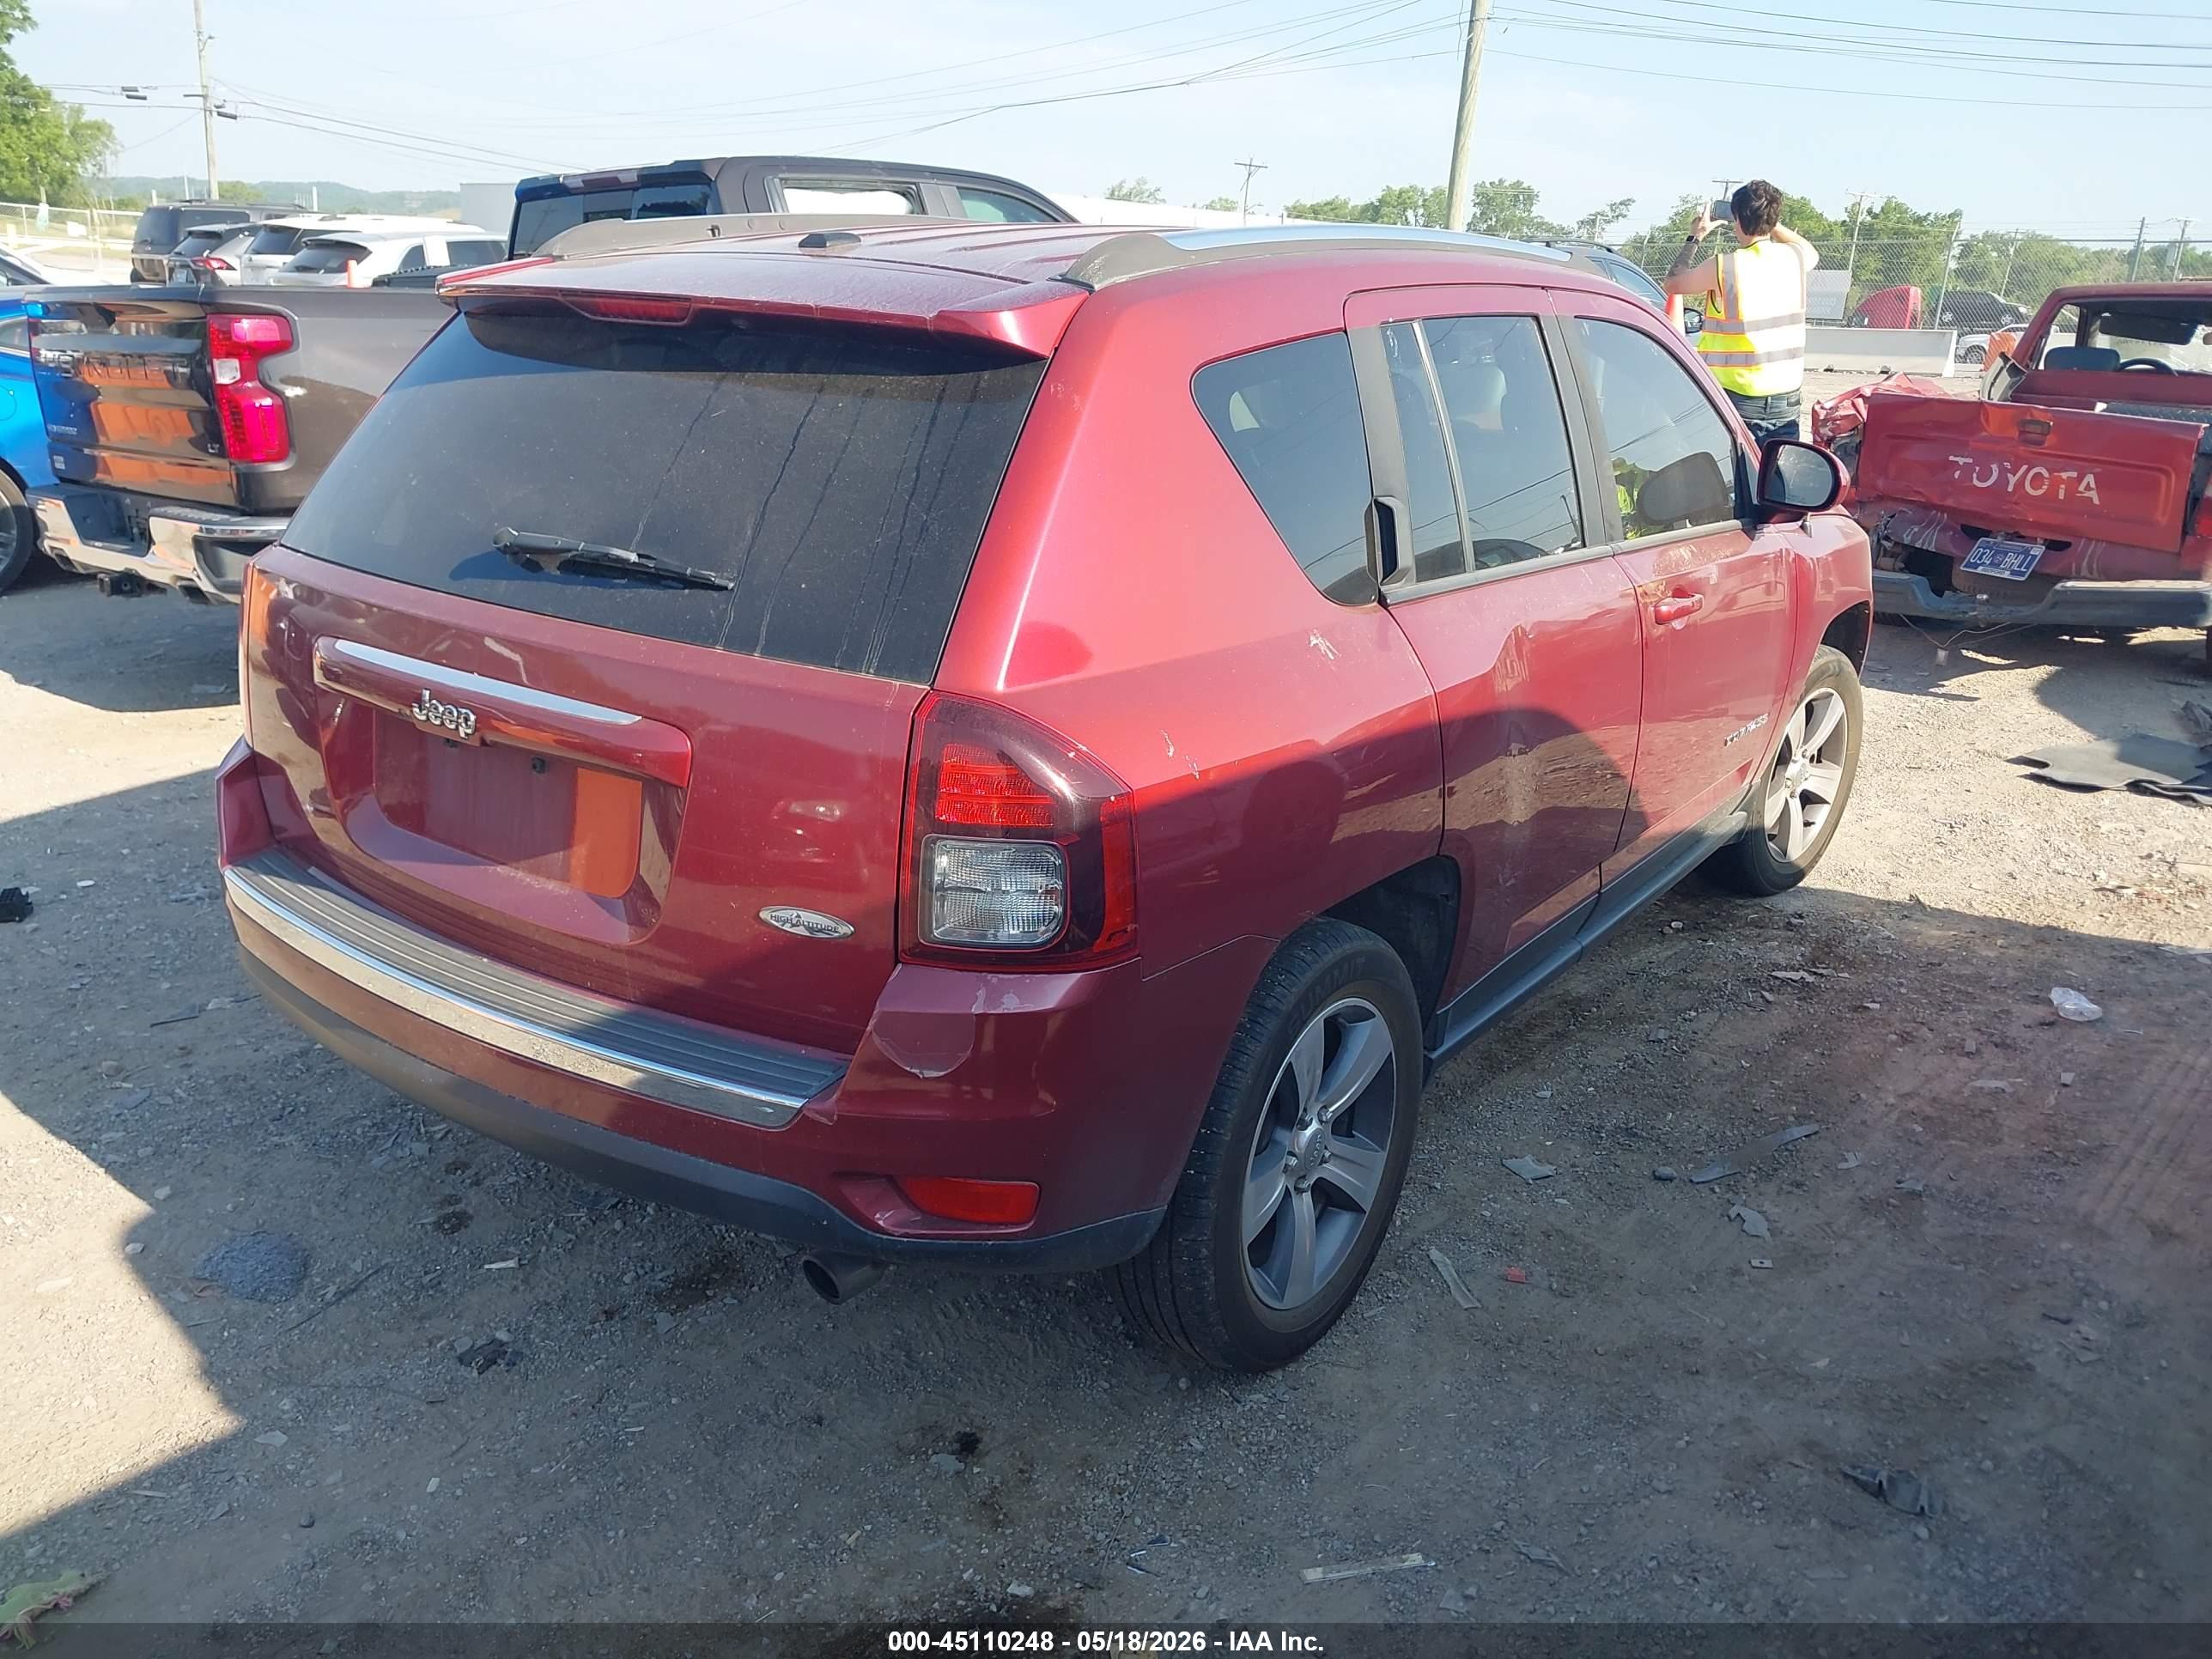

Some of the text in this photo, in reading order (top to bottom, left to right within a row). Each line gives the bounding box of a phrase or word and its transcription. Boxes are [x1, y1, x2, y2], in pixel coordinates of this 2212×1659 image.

[1948, 455, 2100, 505] TOYOTA
[1969, 548, 2033, 571] 034 BHLL
[412, 688, 477, 739] Jeep
[769, 914, 841, 933] HIGH ALTITUDE
